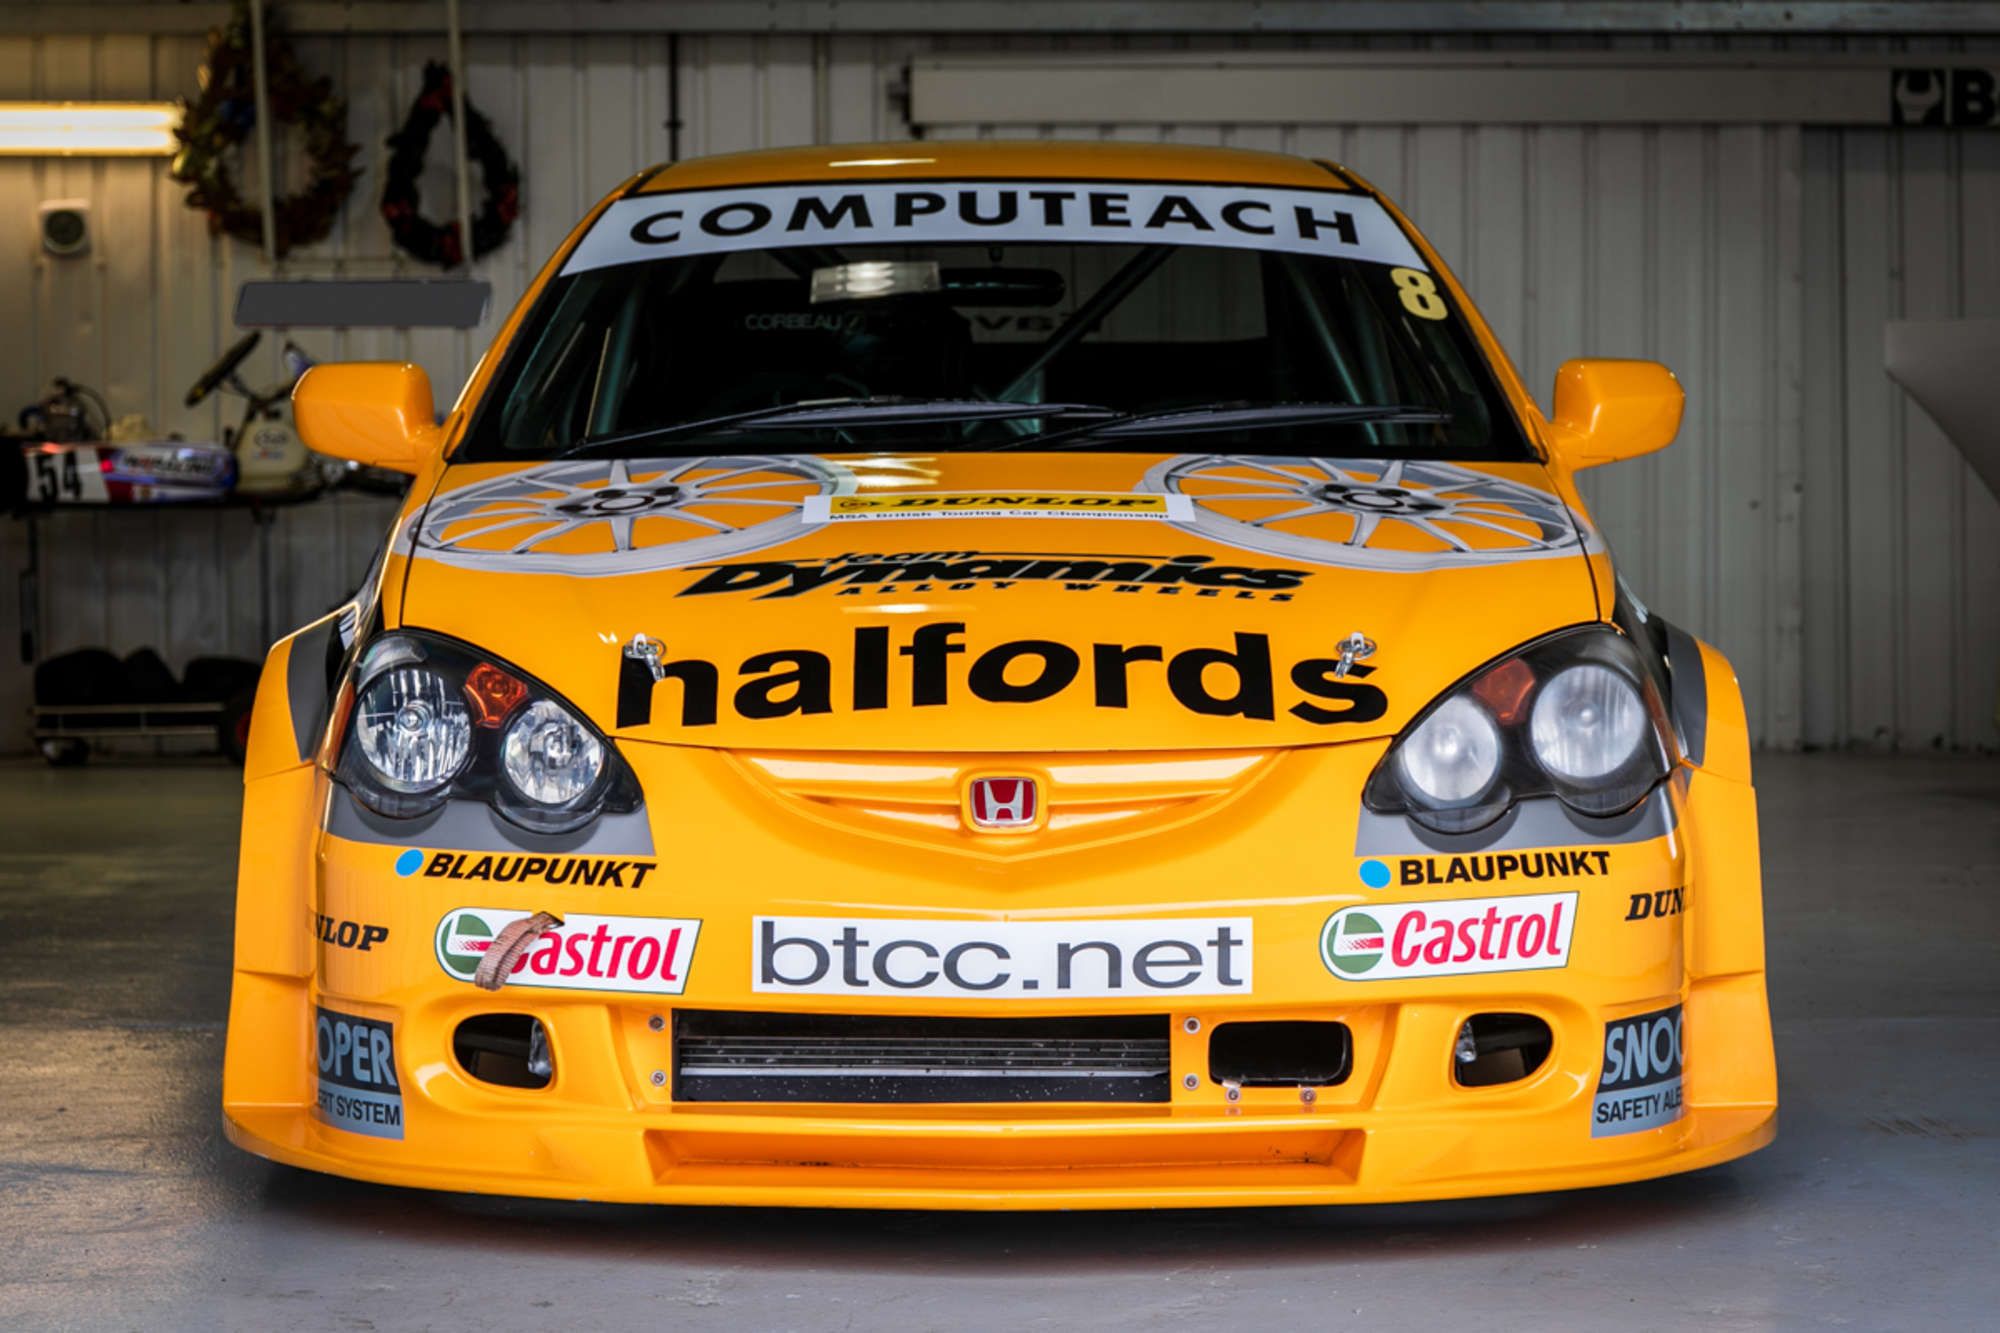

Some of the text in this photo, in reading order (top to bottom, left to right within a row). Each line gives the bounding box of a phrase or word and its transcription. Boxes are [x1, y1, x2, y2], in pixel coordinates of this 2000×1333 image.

[629, 190, 1360, 246] COMPUTEACH
[1391, 267, 1448, 320] 8
[744, 312, 842, 332] CORBEAU
[36, 451, 82, 501] 54
[891, 496, 1158, 507] DUNLOP
[1048, 510, 1169, 519] Championship
[834, 580, 1295, 603] ALLOY WHEELS
[616, 622, 1389, 729] halfords
[424, 852, 658, 889] BLAUPUNKT
[1399, 851, 1611, 886] BLAUPUNKT
[1391, 902, 1563, 968] Castrol
[761, 920, 1244, 990] btcc.net
[317, 1014, 398, 1087] OPER
[336, 1095, 401, 1126] SYSTEM
[1597, 1092, 1660, 1124] SAFETY
